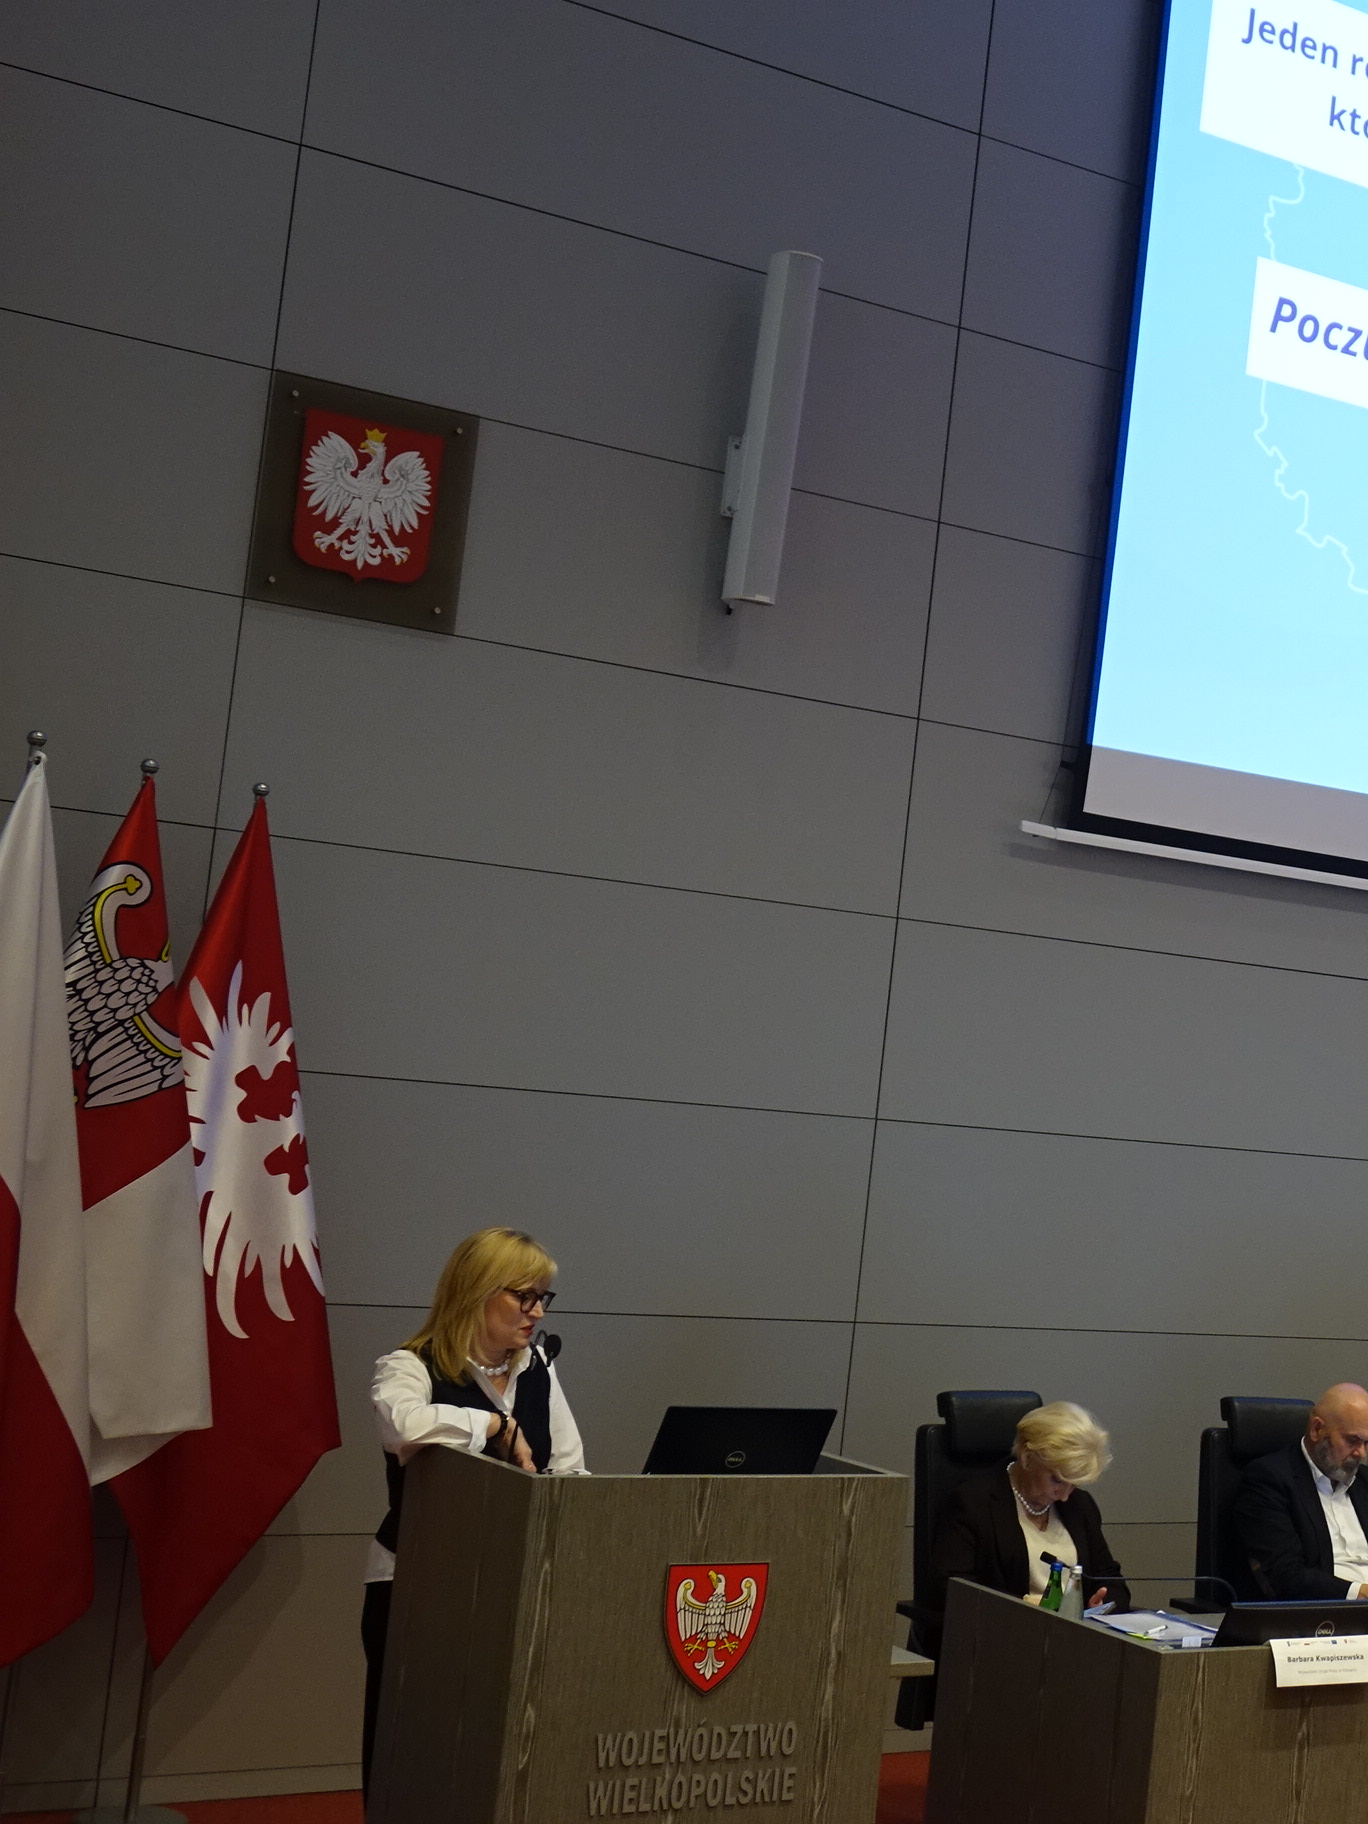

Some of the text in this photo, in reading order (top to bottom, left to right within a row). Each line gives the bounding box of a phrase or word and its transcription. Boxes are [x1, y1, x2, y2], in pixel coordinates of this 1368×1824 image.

[1241, 7, 1339, 69] Jeden
[1287, 1653, 1364, 1663] Barbara Kwapiszewska
[596, 1717, 798, 1769] WOJEWÓDZTWO
[587, 1767, 797, 1817] WIELKOPOLSKIE
